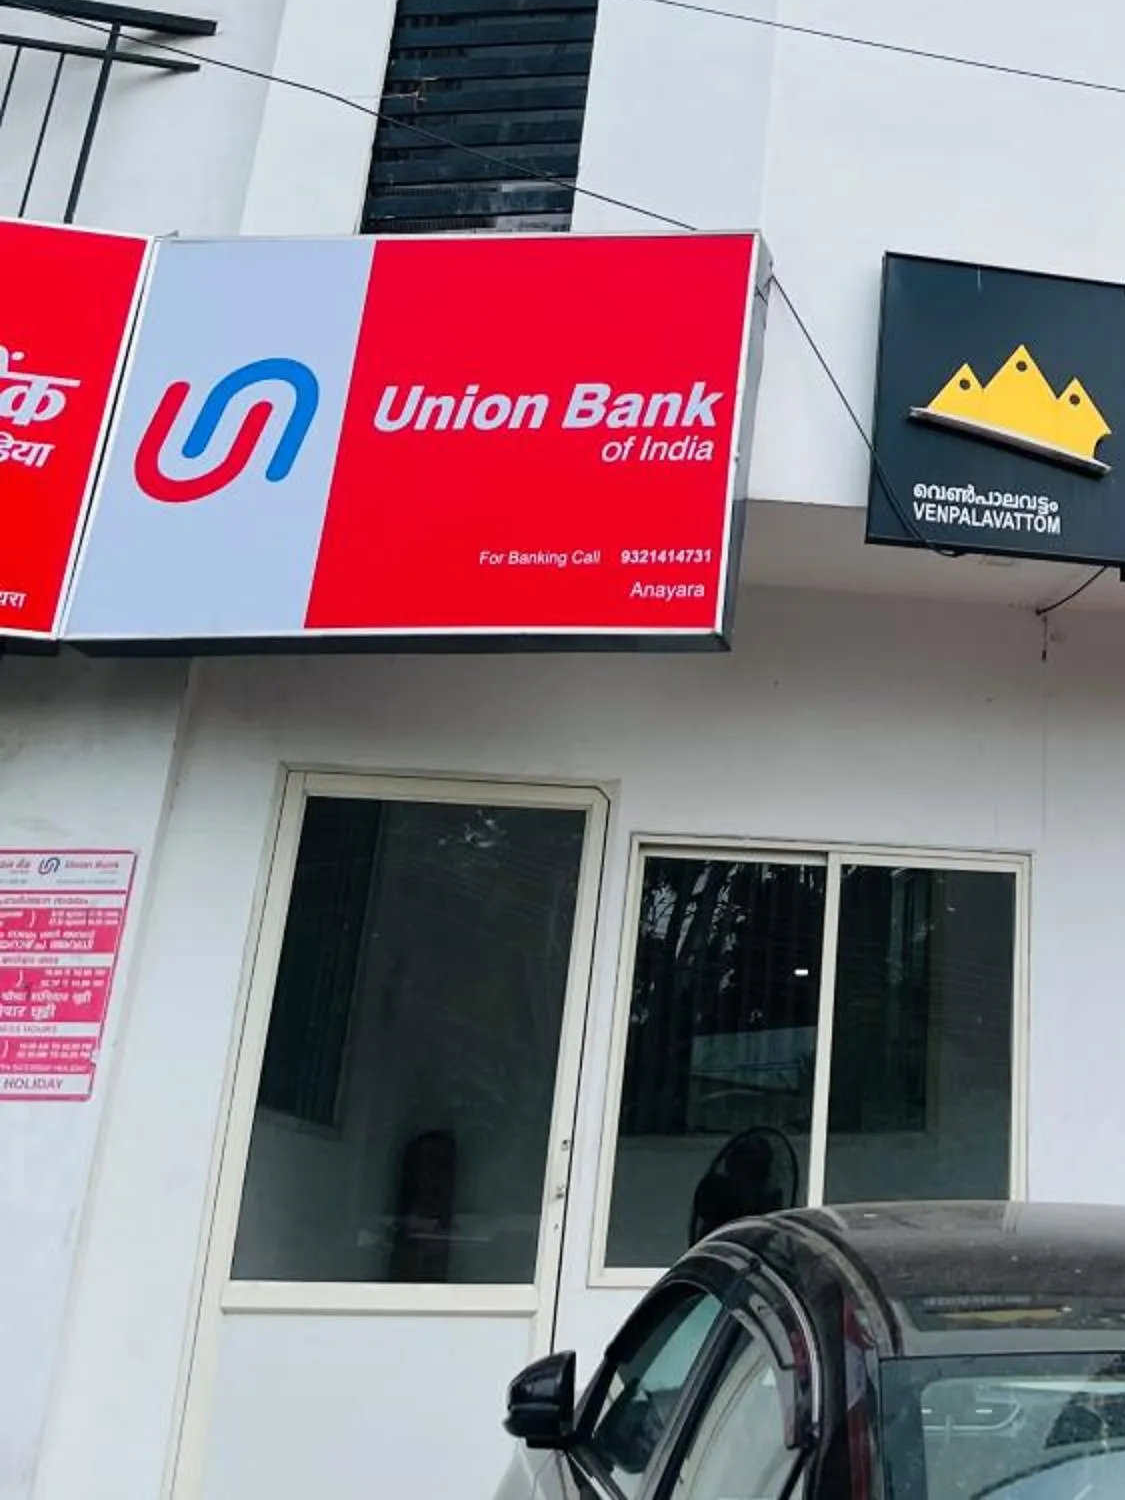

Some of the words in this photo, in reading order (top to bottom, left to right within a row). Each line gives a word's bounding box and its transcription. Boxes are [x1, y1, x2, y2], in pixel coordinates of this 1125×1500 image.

[373, 384, 549, 432] Union
[562, 381, 723, 430] Bank
[601, 436, 637, 463] of
[640, 435, 714, 462] India
[913, 501, 1061, 535] VENPALAVATTOM
[479, 550, 503, 565] For
[508, 549, 568, 568] Banking
[571, 550, 601, 565] Call
[620, 548, 711, 564] 9321414731
[629, 581, 705, 602] Anayara
[4, 1077, 64, 1090] HOLIDAY
